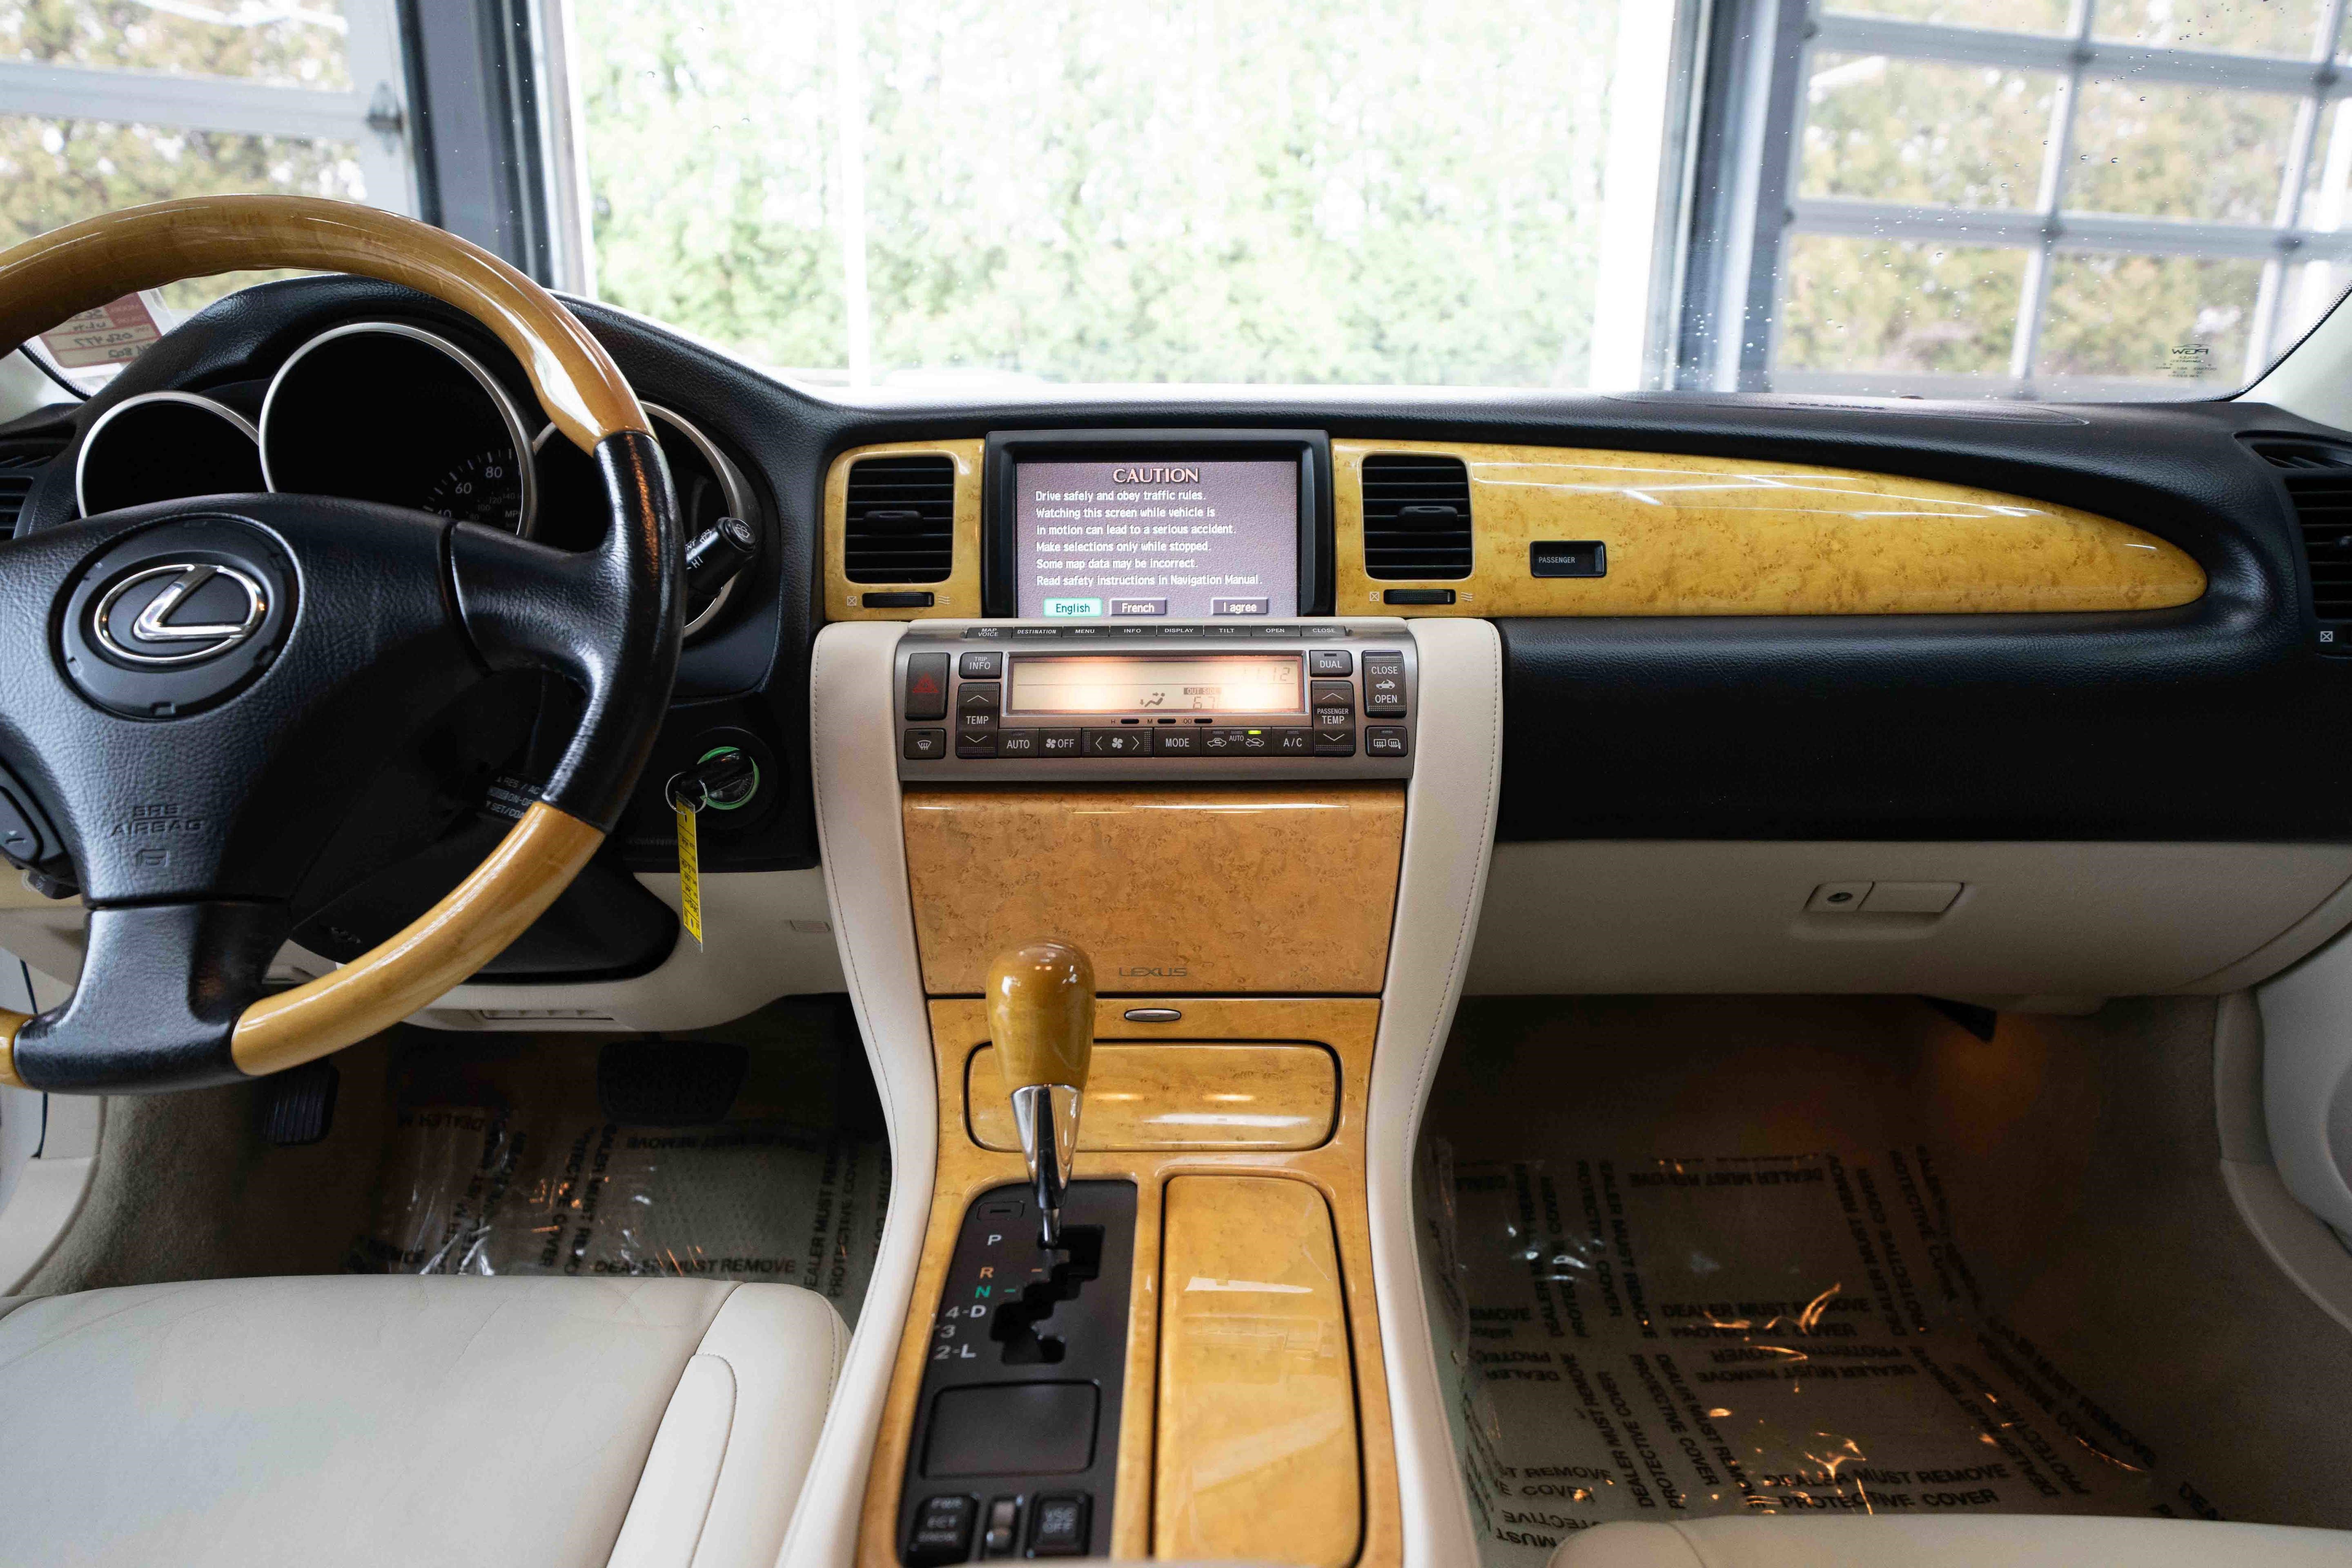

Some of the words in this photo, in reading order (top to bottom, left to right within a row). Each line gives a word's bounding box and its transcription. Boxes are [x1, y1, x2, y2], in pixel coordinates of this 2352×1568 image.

[485, 466, 503, 479] 80
[1113, 468, 1199, 483] CAUTION
[454, 482, 472, 494] 60
[1036, 490, 1061, 501] Drive
[1064, 490, 1094, 502] safely
[1096, 490, 1114, 501] and
[1117, 490, 1140, 502] obey
[1143, 490, 1176, 500] traffic
[1178, 490, 1206, 500] rules.
[1036, 508, 1081, 519] Watching
[1084, 508, 1102, 518] this
[1105, 509, 1137, 518] screen
[1140, 507, 1166, 517] while
[1168, 507, 1203, 517] vehicle
[1207, 507, 1216, 517] is
[1036, 525, 1046, 535] in
[1049, 525, 1082, 535] motion
[1085, 526, 1103, 535] can
[1107, 525, 1127, 535] lead
[1129, 525, 1141, 535] to
[1143, 526, 1150, 534] a
[1153, 524, 1188, 534] serious
[1191, 524, 1236, 534] accident.
[1036, 542, 1061, 552] Make
[1063, 541, 1114, 552] selections
[1116, 541, 1138, 553] only
[1141, 541, 1167, 551] while
[1169, 541, 1212, 552] stopped.
[1036, 559, 1062, 569] Some
[1066, 560, 1085, 570] map
[1088, 559, 1110, 569] data
[1113, 560, 1131, 570] may
[1134, 559, 1147, 568] be
[1150, 559, 1198, 568] incorrect.
[1036, 575, 1060, 586] Read
[1063, 575, 1093, 587] safety
[1097, 575, 1155, 585] instructions
[1158, 575, 1168, 585] in
[1170, 575, 1222, 586] Navigation
[1225, 575, 1263, 585] Manual.
[1056, 603, 1090, 615] English
[1122, 603, 1155, 612] French
[1223, 602, 1227, 612] I
[1229, 604, 1257, 614] agree
[969, 661, 991, 670] INFO
[1320, 660, 1343, 668] DUAL
[1371, 666, 1398, 675] CLOSE
[1375, 695, 1398, 704] OPEN
[966, 715, 989, 725] TEMP
[1322, 715, 1345, 724] TEMP
[1007, 739, 1030, 749] AUTO
[1058, 739, 1074, 748] OFF
[1165, 738, 1190, 748] MODE
[1283, 738, 1303, 747] A/C
[131, 804, 179, 817] SRS
[109, 819, 203, 837] AIRBAG
[1118, 967, 1188, 977] LEXUS
[987, 1234, 1002, 1246] P
[720, 1259, 796, 1273] REMOVE
[979, 1267, 994, 1279] R
[974, 1285, 992, 1298] N
[940, 1325, 956, 1339] 3
[1588, 1408, 1624, 1449] MUST
[1622, 1419, 1686, 1512] PROTECTIVE
[1678, 1436, 1721, 1487] COVER
[1525, 1467, 1611, 1482] REMOVE
[1610, 1449, 1656, 1509] DEALER
[1851, 1469, 1912, 1485] MUST
[1918, 1462, 2010, 1485] REMOVE
[1922, 1488, 2000, 1507] COVER
[1496, 1527, 1558, 1549] MUST
